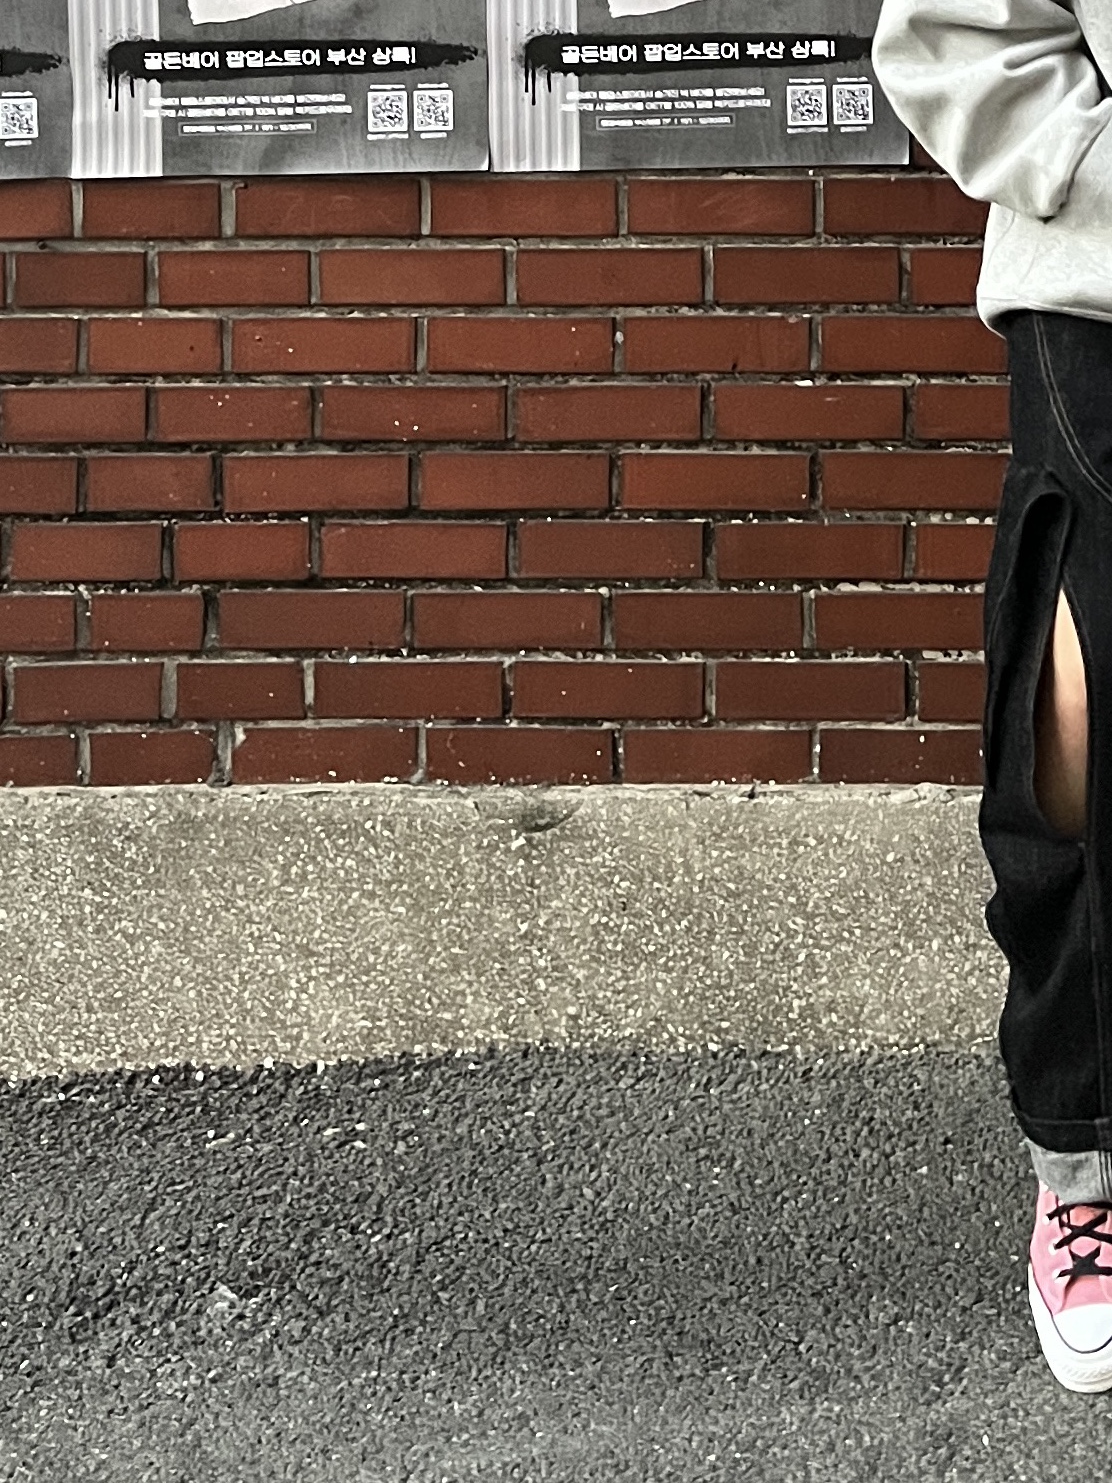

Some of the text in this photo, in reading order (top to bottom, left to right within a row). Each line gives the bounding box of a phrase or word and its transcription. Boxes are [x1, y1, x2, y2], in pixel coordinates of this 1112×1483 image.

[143, 51, 220, 70] 골든베어
[225, 49, 320, 68] 팝업스토어
[326, 48, 366, 66] 부산
[561, 45, 638, 64] 골든베어
[643, 42, 740, 62] 팝업스토어
[746, 41, 785, 59] 부산
